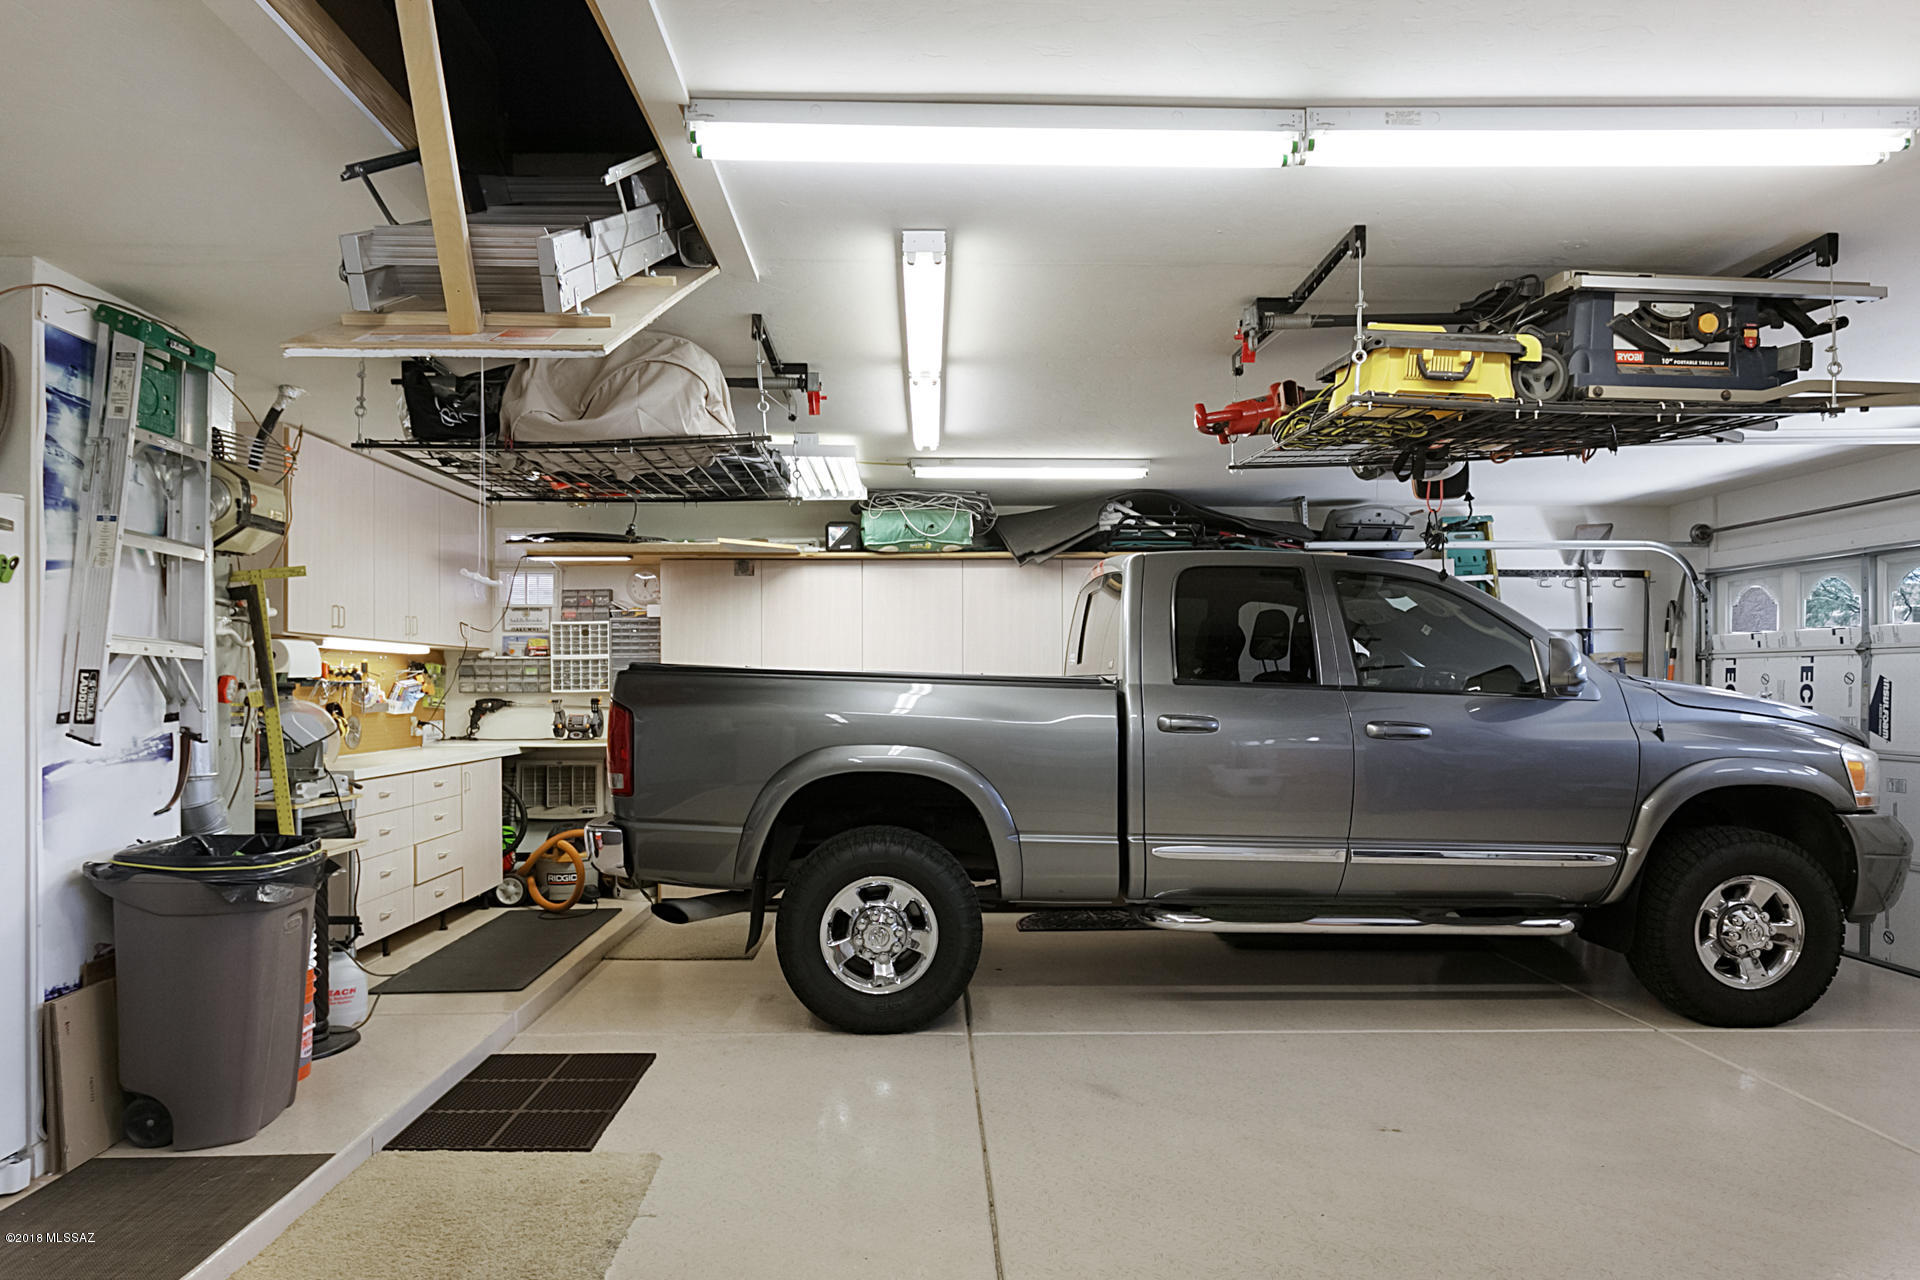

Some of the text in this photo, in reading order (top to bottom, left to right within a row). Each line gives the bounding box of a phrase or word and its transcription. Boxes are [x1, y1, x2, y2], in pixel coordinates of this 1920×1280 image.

[1616, 352, 1643, 361] RYOBI
[76, 672, 90, 721] LADDERS
[548, 874, 577, 882] RIDGID
